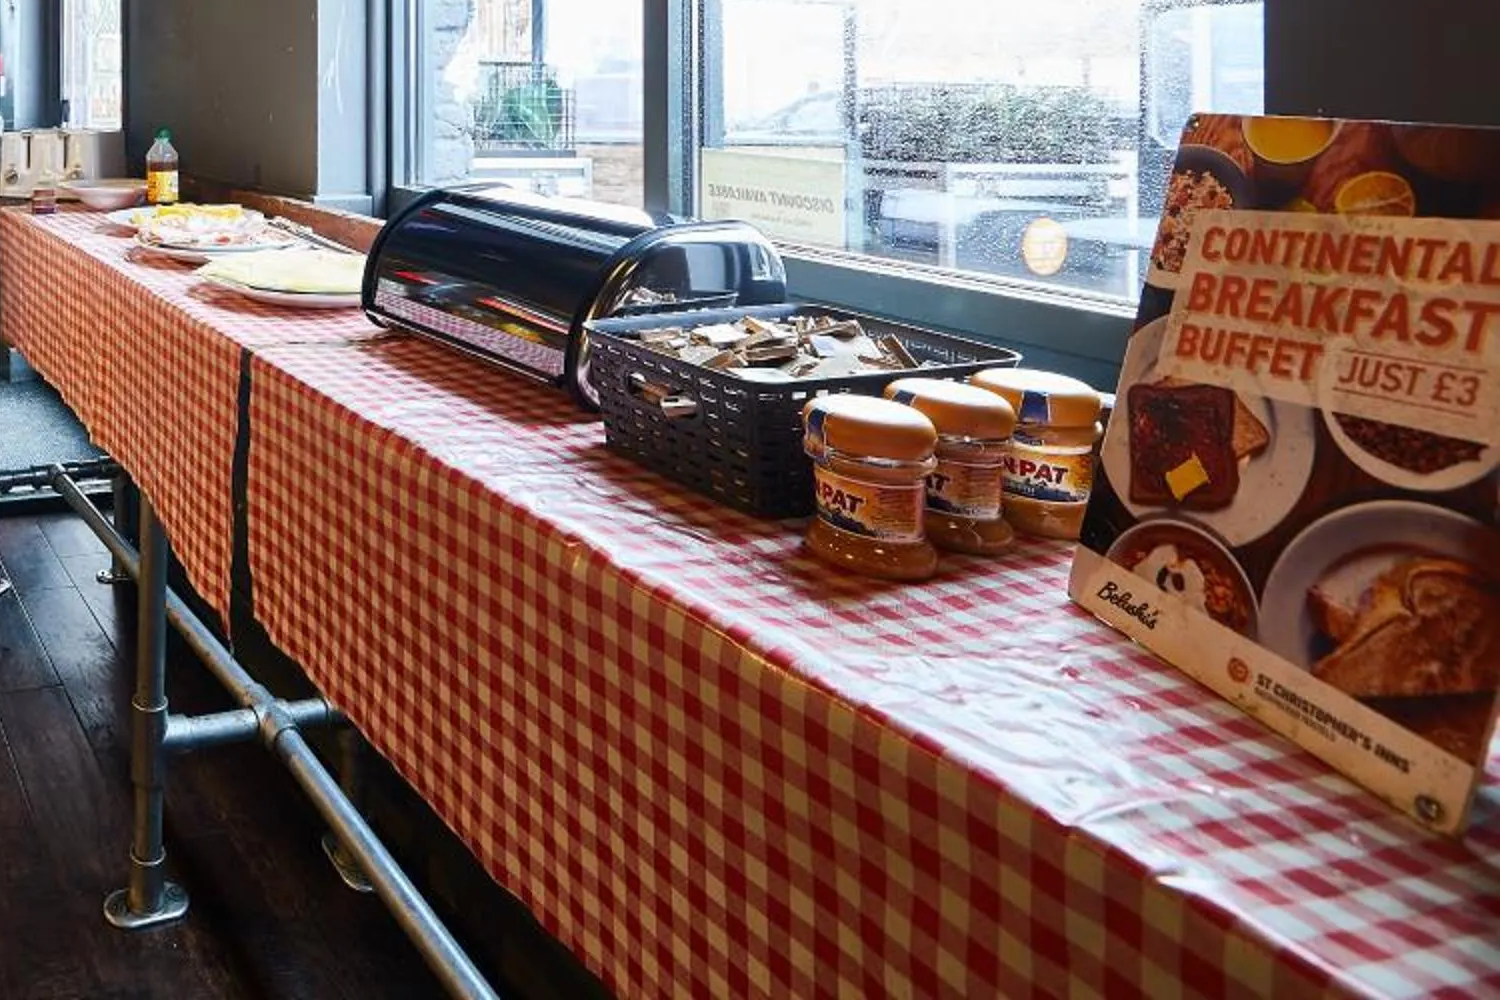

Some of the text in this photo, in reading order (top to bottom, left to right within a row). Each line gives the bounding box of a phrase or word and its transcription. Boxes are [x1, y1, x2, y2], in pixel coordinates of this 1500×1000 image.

[1201, 225, 1500, 286] CONTINENTAL
[1187, 273, 1500, 353] BREAKFAST
[1176, 323, 1325, 382] BUFFET
[1338, 356, 1481, 407] JUST £3
[1097, 581, 1159, 630] Belushi's
[1257, 673, 1273, 690] ST
[1273, 684, 1372, 751] CHRISTOPHER'S
[1373, 743, 1410, 774] INNS
